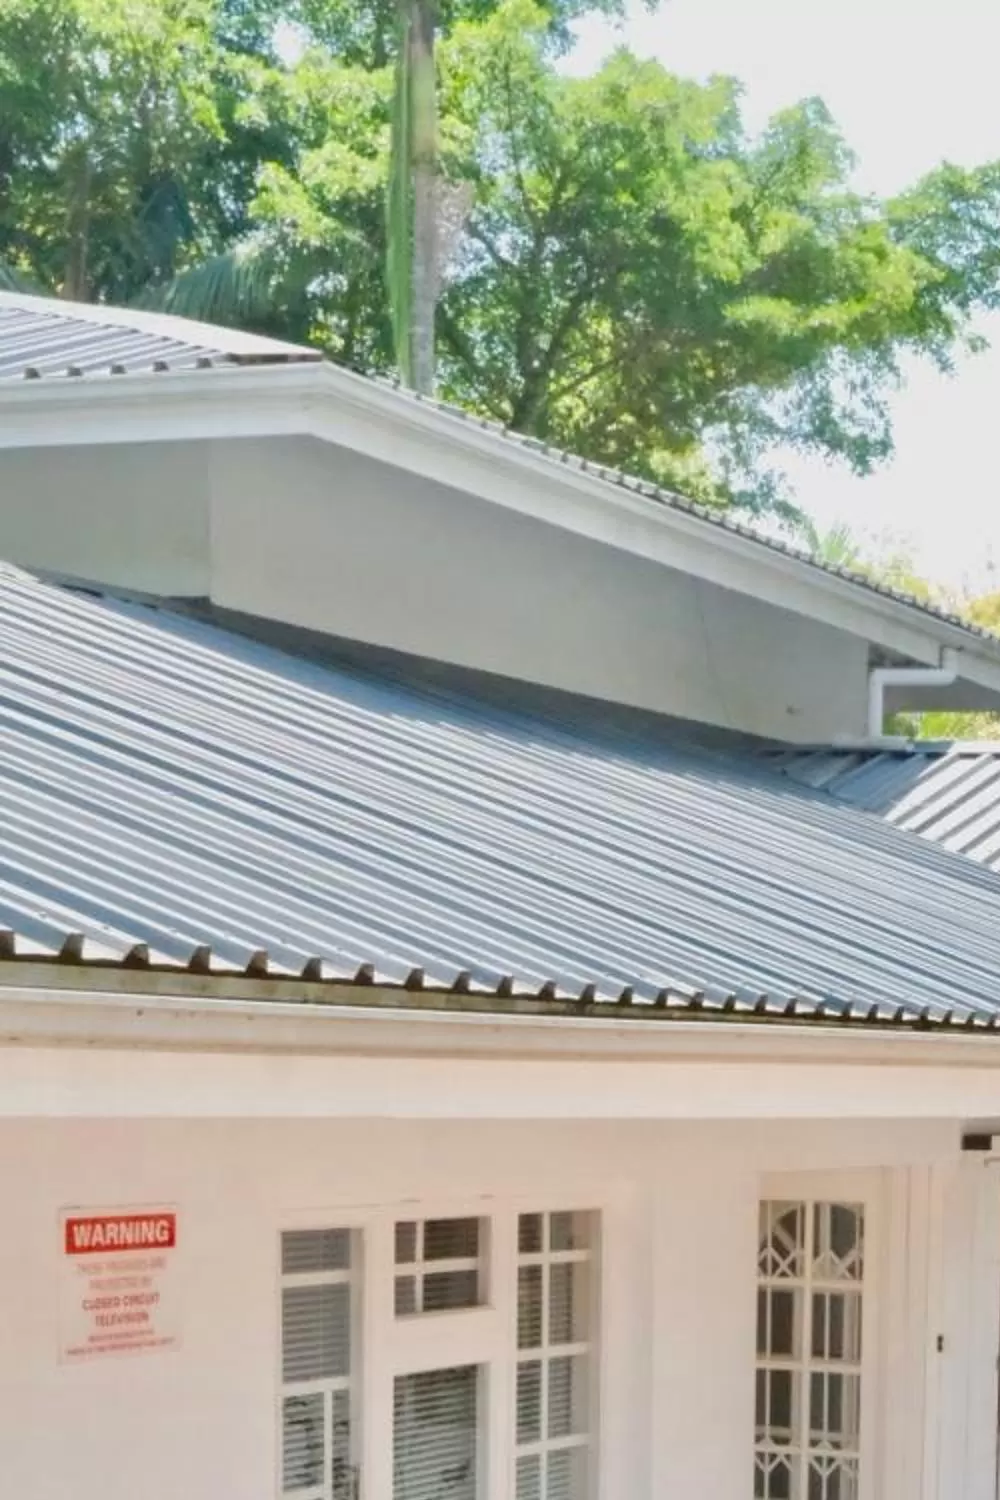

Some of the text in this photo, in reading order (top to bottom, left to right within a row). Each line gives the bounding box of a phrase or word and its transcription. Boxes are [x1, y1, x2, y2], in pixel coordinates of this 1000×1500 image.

[73, 1219, 169, 1248] WARNING
[82, 1292, 160, 1310] CLOSED CIRCUIT
[95, 1311, 149, 1327] TELEVISION
